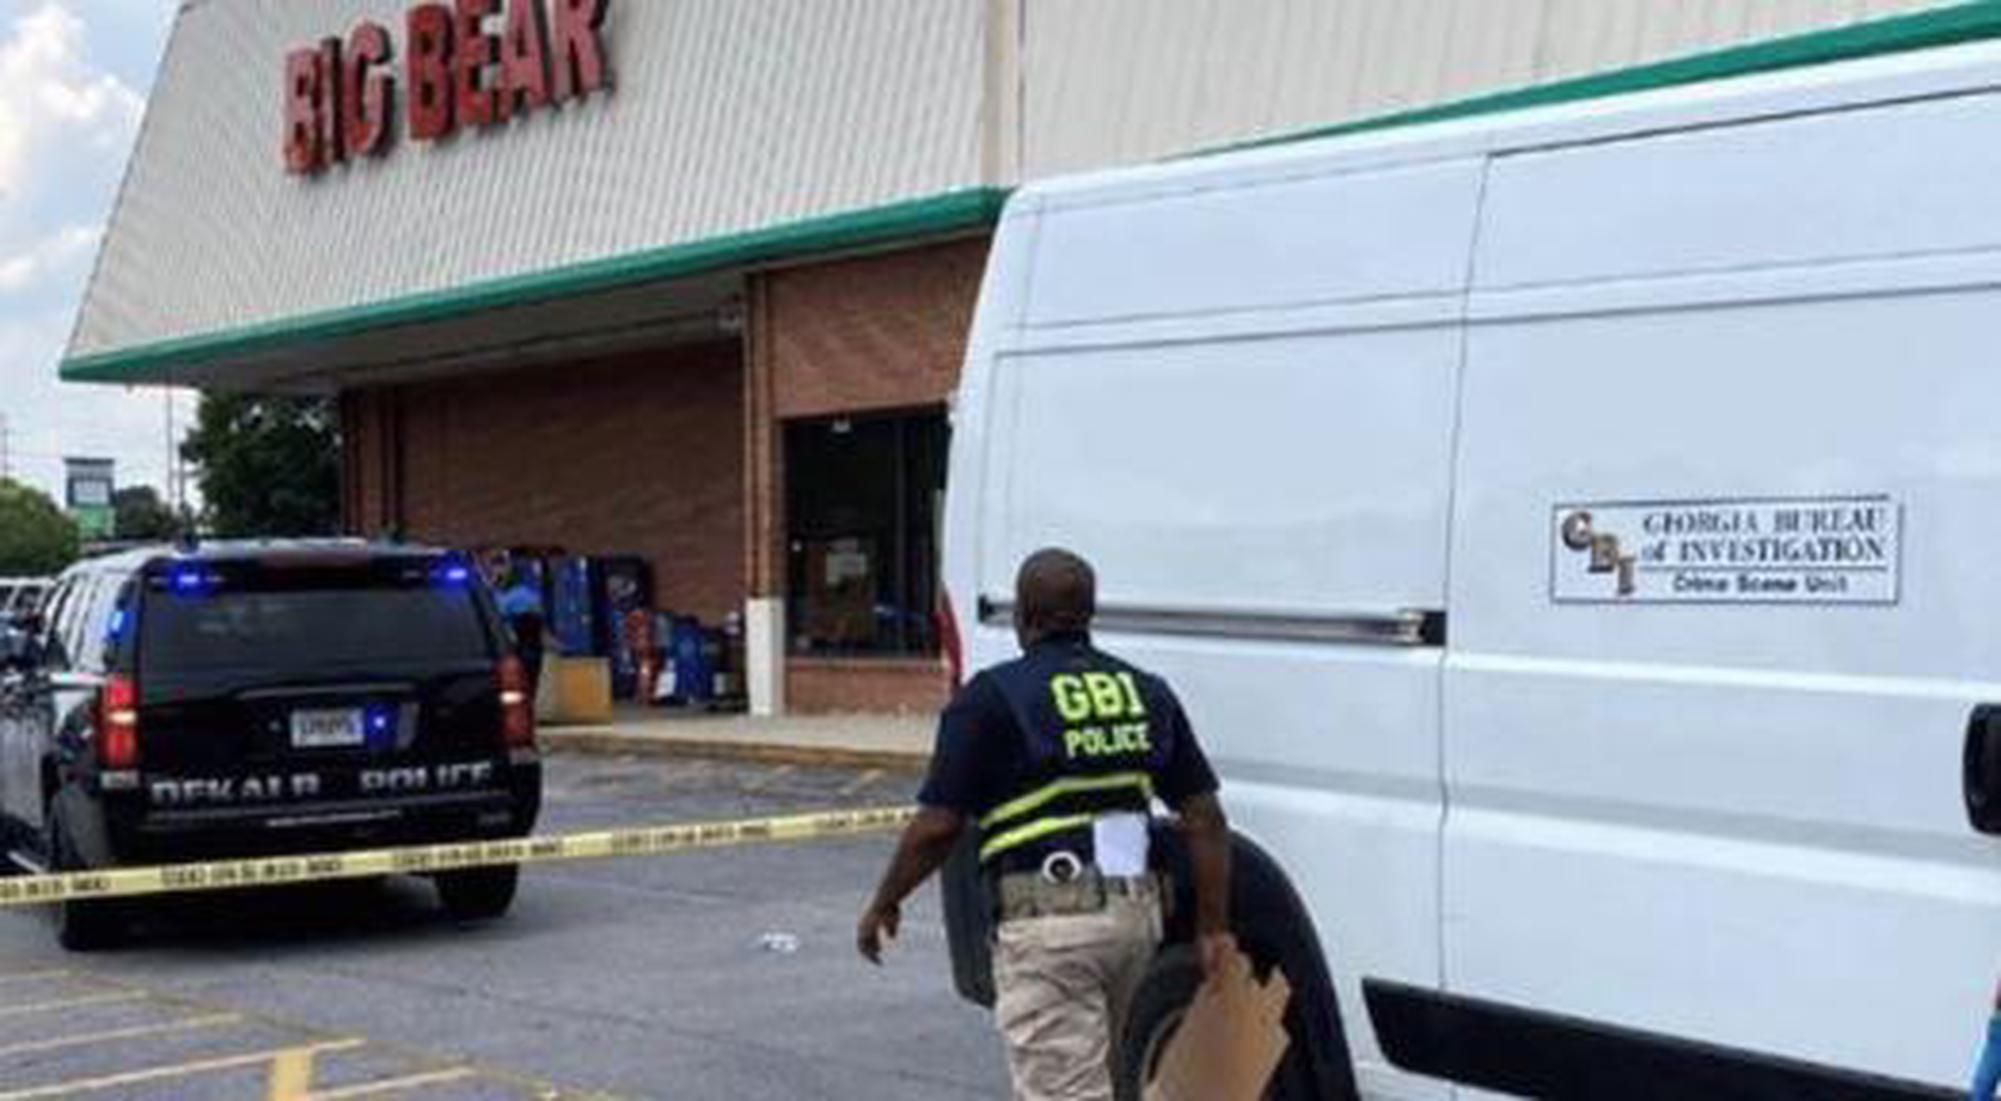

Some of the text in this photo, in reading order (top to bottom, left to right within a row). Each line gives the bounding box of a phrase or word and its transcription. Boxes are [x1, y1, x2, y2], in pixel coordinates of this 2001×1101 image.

[283, 0, 612, 176] BIG BEAR
[1644, 507, 1887, 534] GEORGIA BUREAU
[1641, 536, 1884, 562] of INVESTIGATION
[1673, 573, 1848, 593] Crime Scene Unit
[1051, 672, 1144, 721] GBI
[1063, 722, 1153, 759] POLICE
